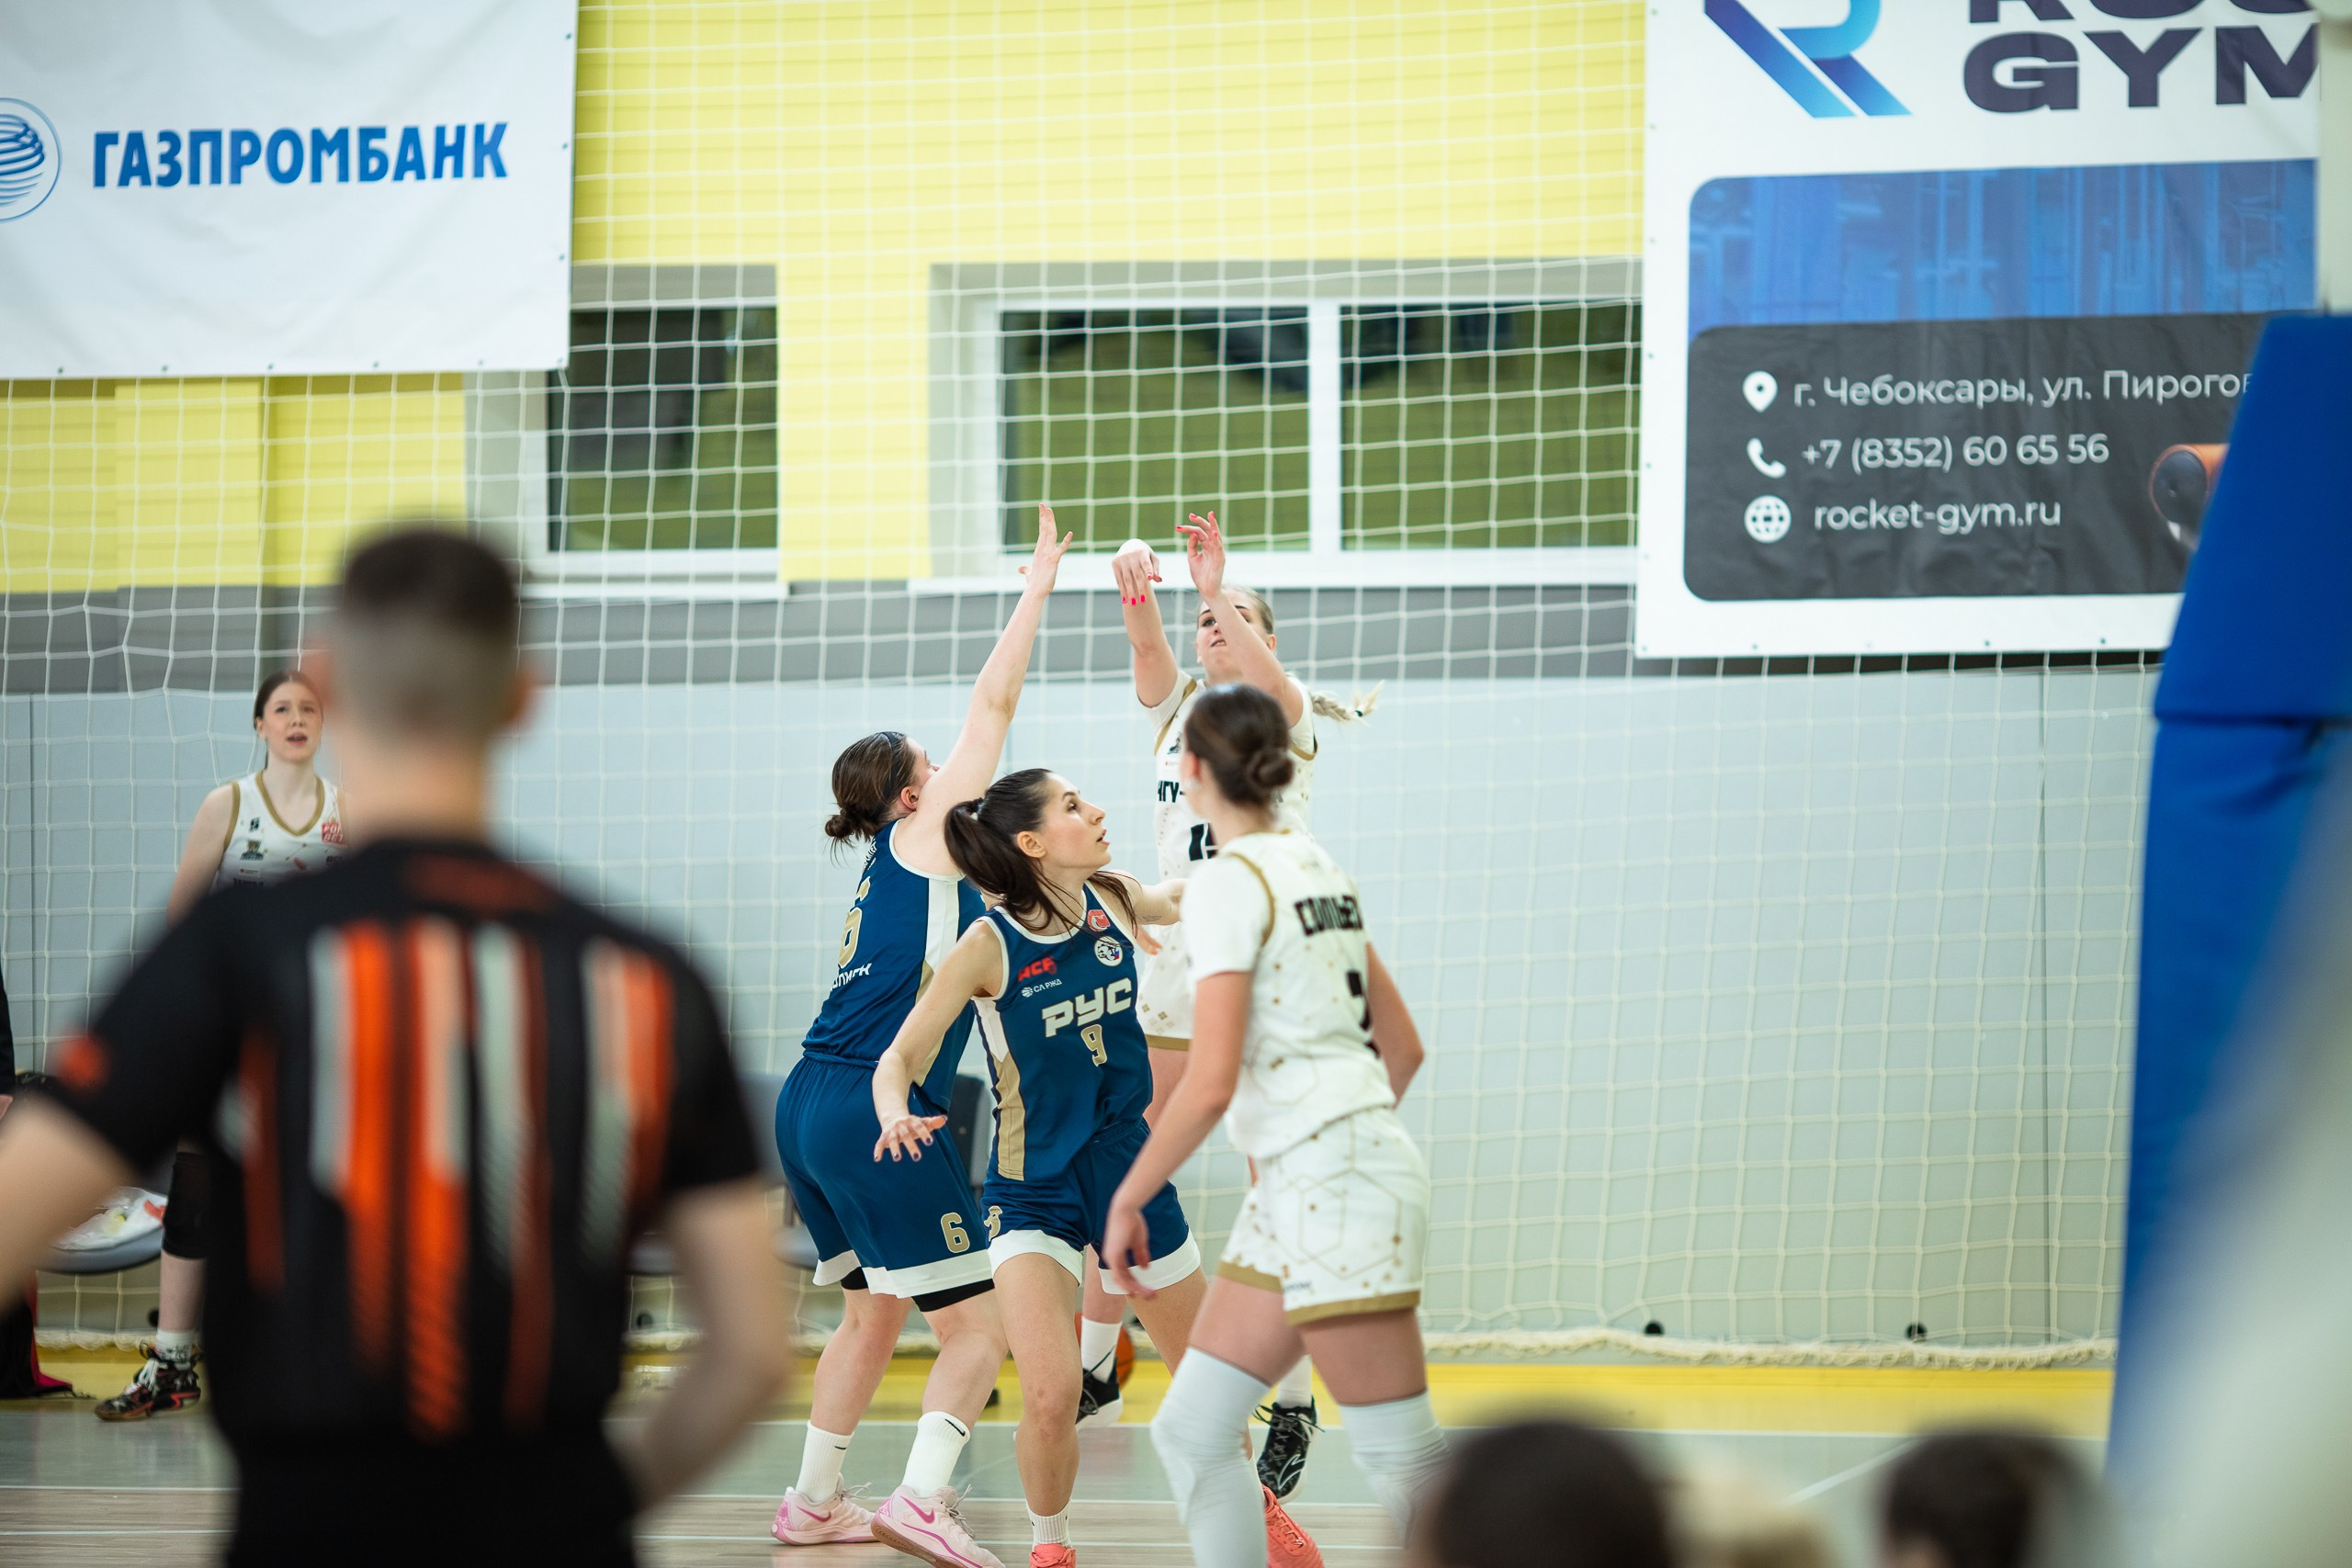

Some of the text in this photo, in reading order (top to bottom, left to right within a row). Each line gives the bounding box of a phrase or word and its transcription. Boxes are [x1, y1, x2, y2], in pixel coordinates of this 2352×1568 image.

[1963, 22, 2320, 114] GYM
[92, 121, 509, 187] ГАЗПРОМБАНК
[1793, 382, 1816, 407] г.
[1823, 373, 2034, 410] Чебоксары,
[2041, 377, 2092, 408] ул.
[1801, 433, 2110, 475] +7 (8352) 60 65 56
[1814, 497, 2061, 535] rocket-gym.ru
[1041, 977, 1132, 1038] РУС
[1080, 1024, 1107, 1066] 9
[940, 1212, 970, 1254] 6
